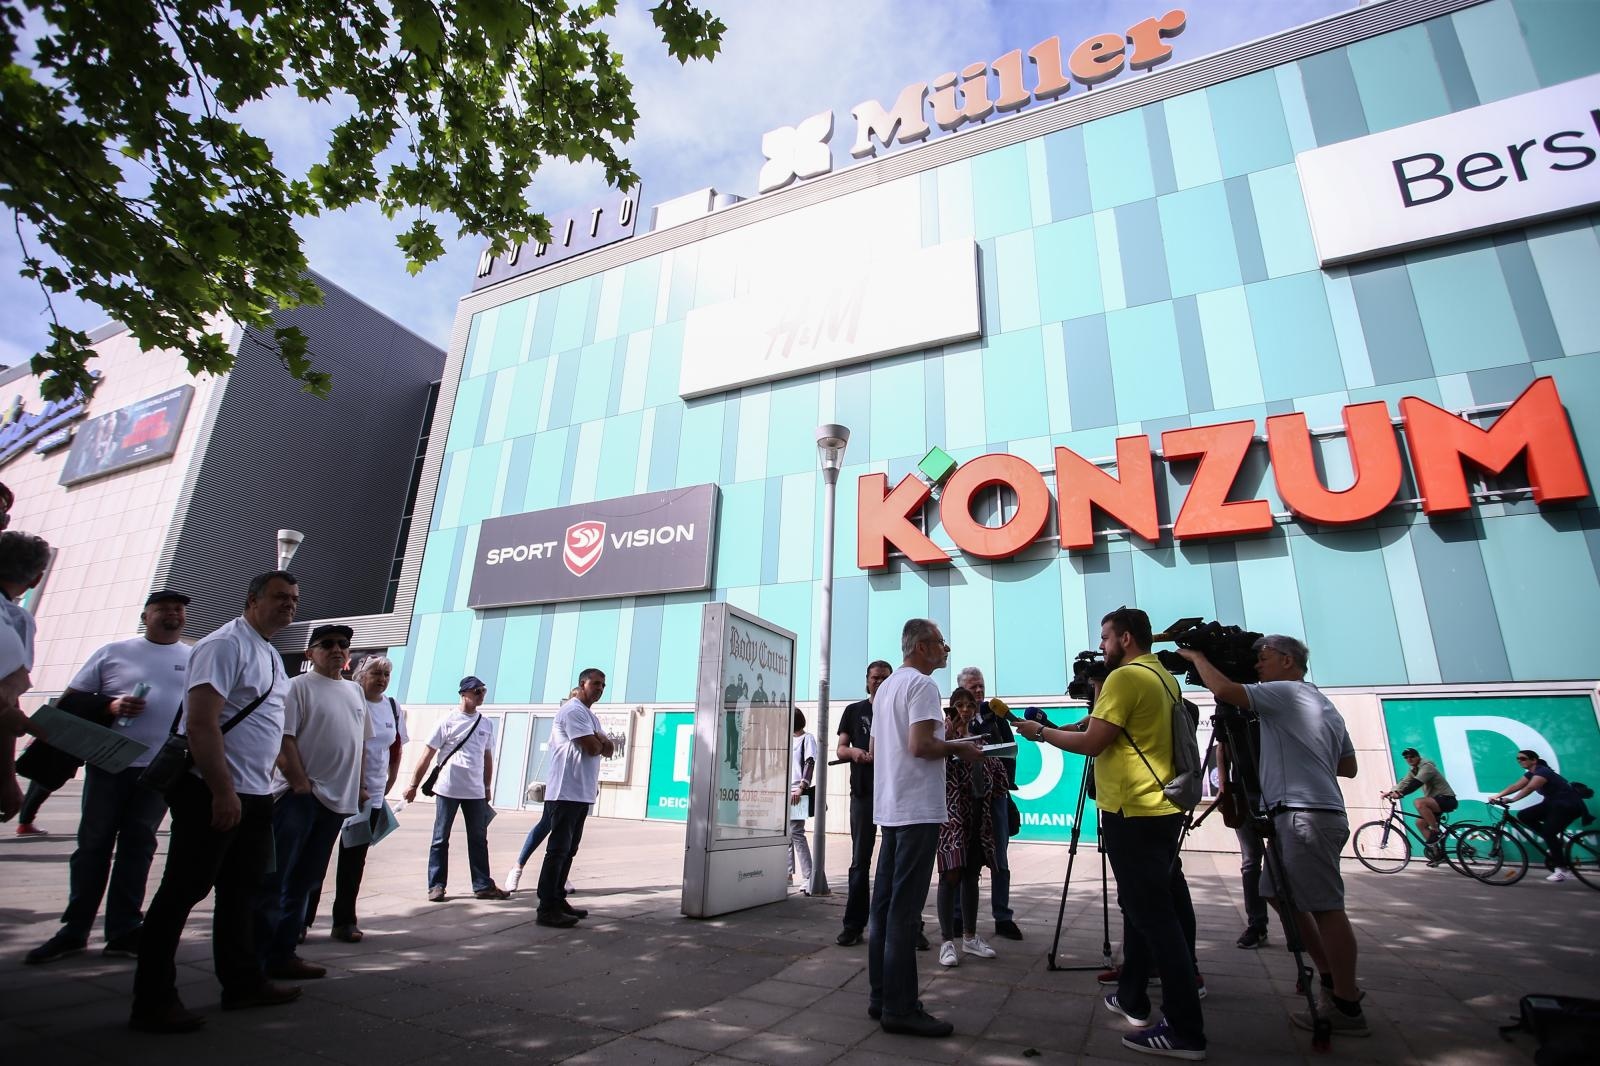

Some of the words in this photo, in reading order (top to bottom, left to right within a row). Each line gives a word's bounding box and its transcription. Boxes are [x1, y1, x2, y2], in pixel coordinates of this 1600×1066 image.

[850, 9, 1187, 159] Müller
[1392, 108, 1600, 208] Bers
[763, 273, 871, 361] H&M
[857, 375, 1589, 569] KONZUM
[486, 541, 558, 565] SPORT
[611, 523, 695, 549] VISION
[730, 626, 758, 671] Body
[759, 640, 788, 676] Count
[659, 796, 690, 809] DEIC
